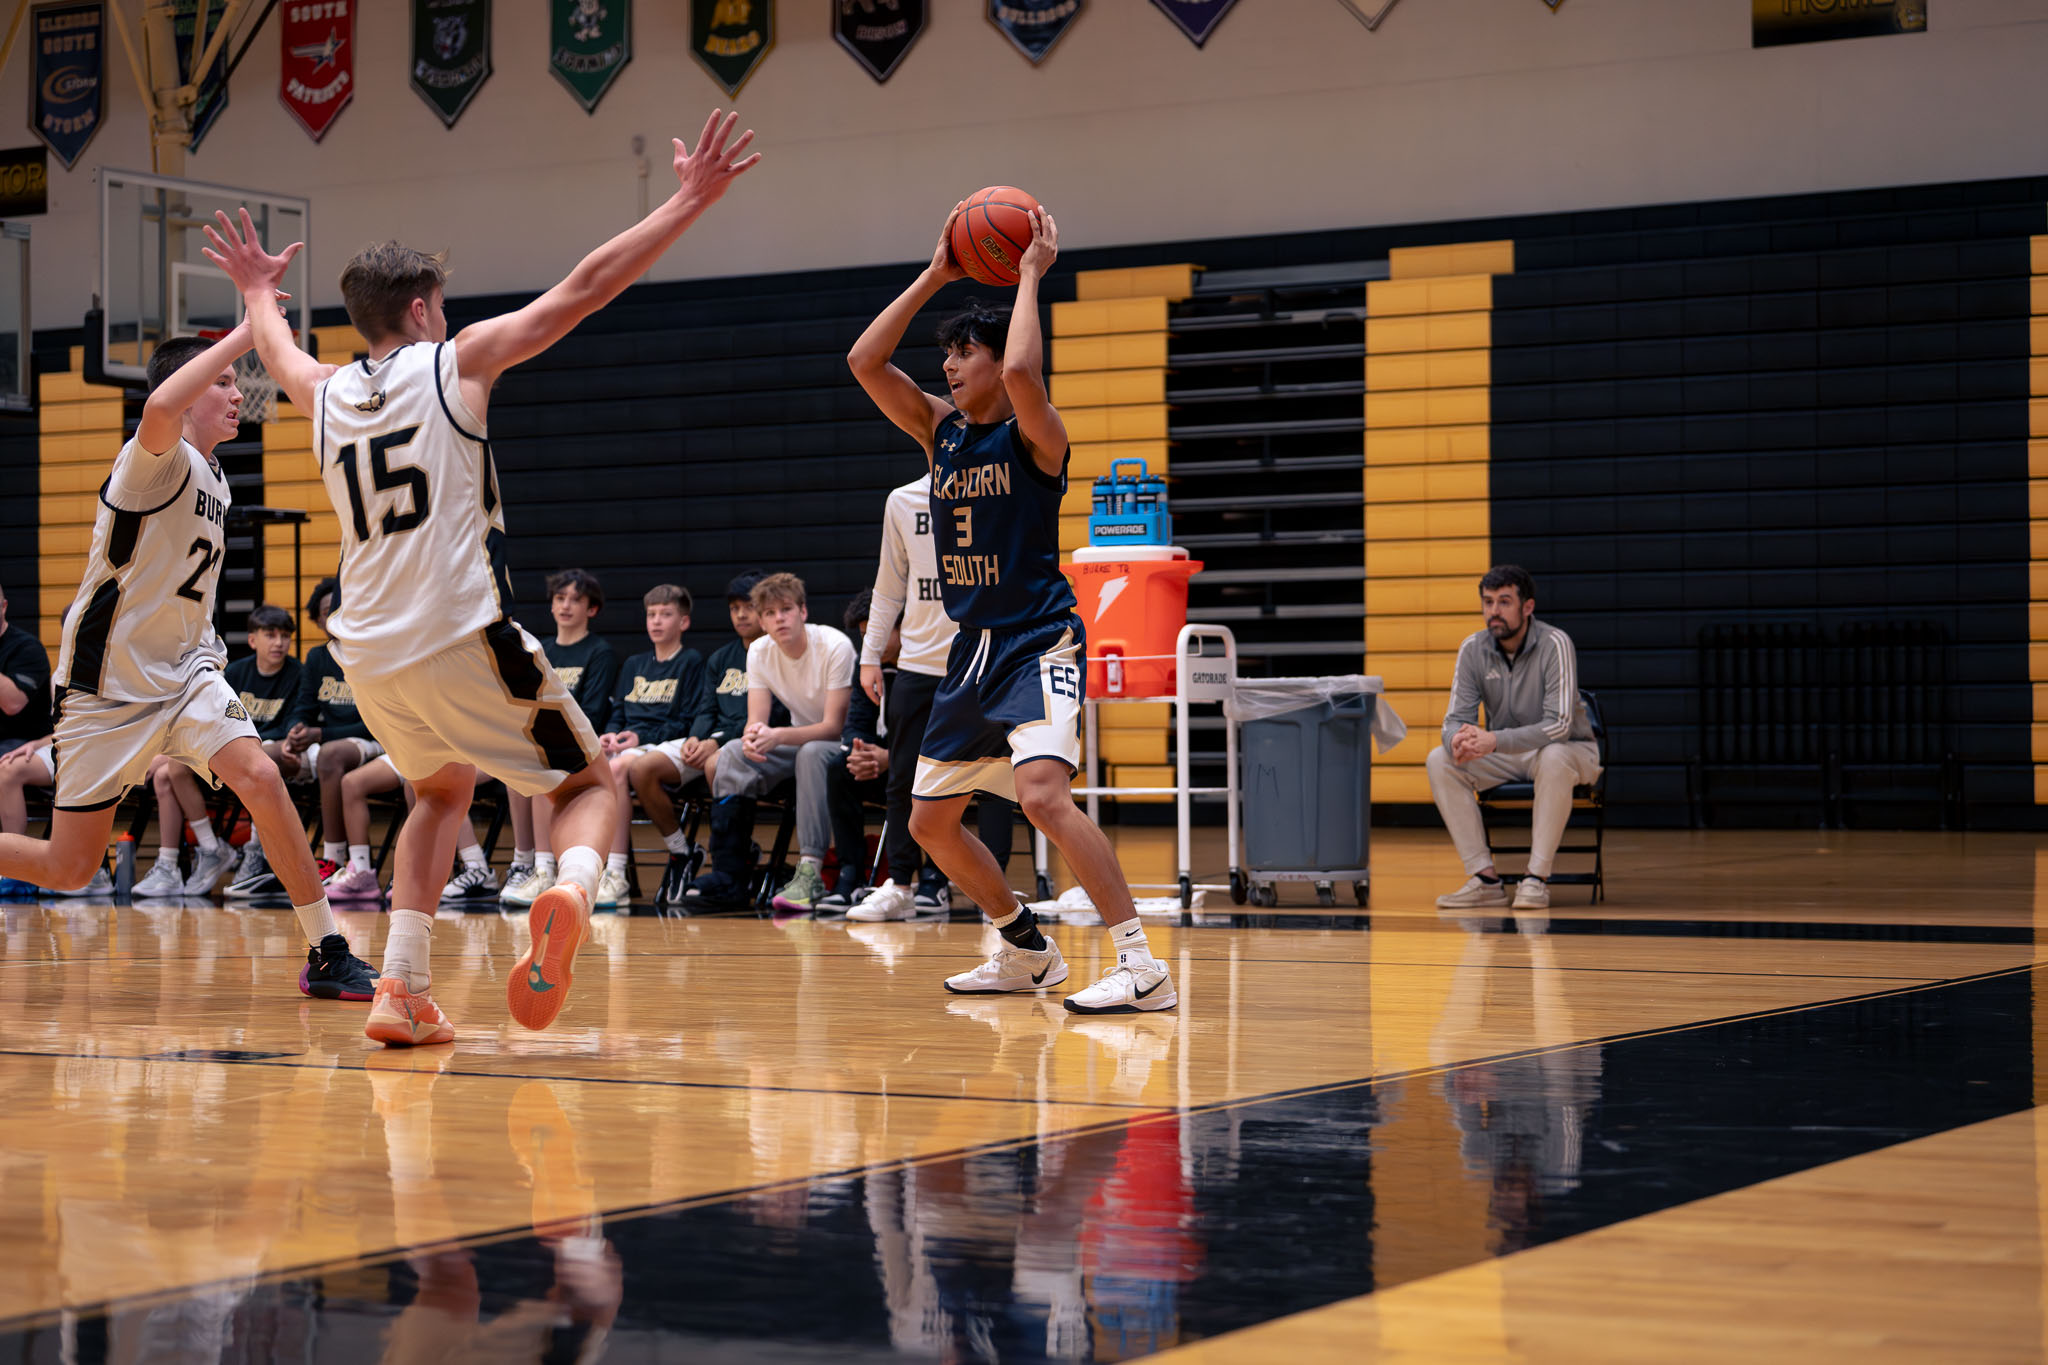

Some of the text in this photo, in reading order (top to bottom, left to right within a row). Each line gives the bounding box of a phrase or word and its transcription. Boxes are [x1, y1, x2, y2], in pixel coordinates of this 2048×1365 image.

[290, 1, 347, 23] SOUTH
[43, 32, 95, 54] SOUTH
[286, 70, 350, 104] PATRIOTS
[43, 108, 94, 134] STORM
[332, 422, 431, 543] 15
[933, 462, 1011, 500] ELKHORN
[953, 506, 972, 547] 3
[1095, 525, 1145, 536] POWERADE
[942, 554, 999, 586] SOUTH
[1050, 665, 1076, 699] ES
[1192, 672, 1227, 684] GATORADE
[1256, 763, 1279, 799] M
